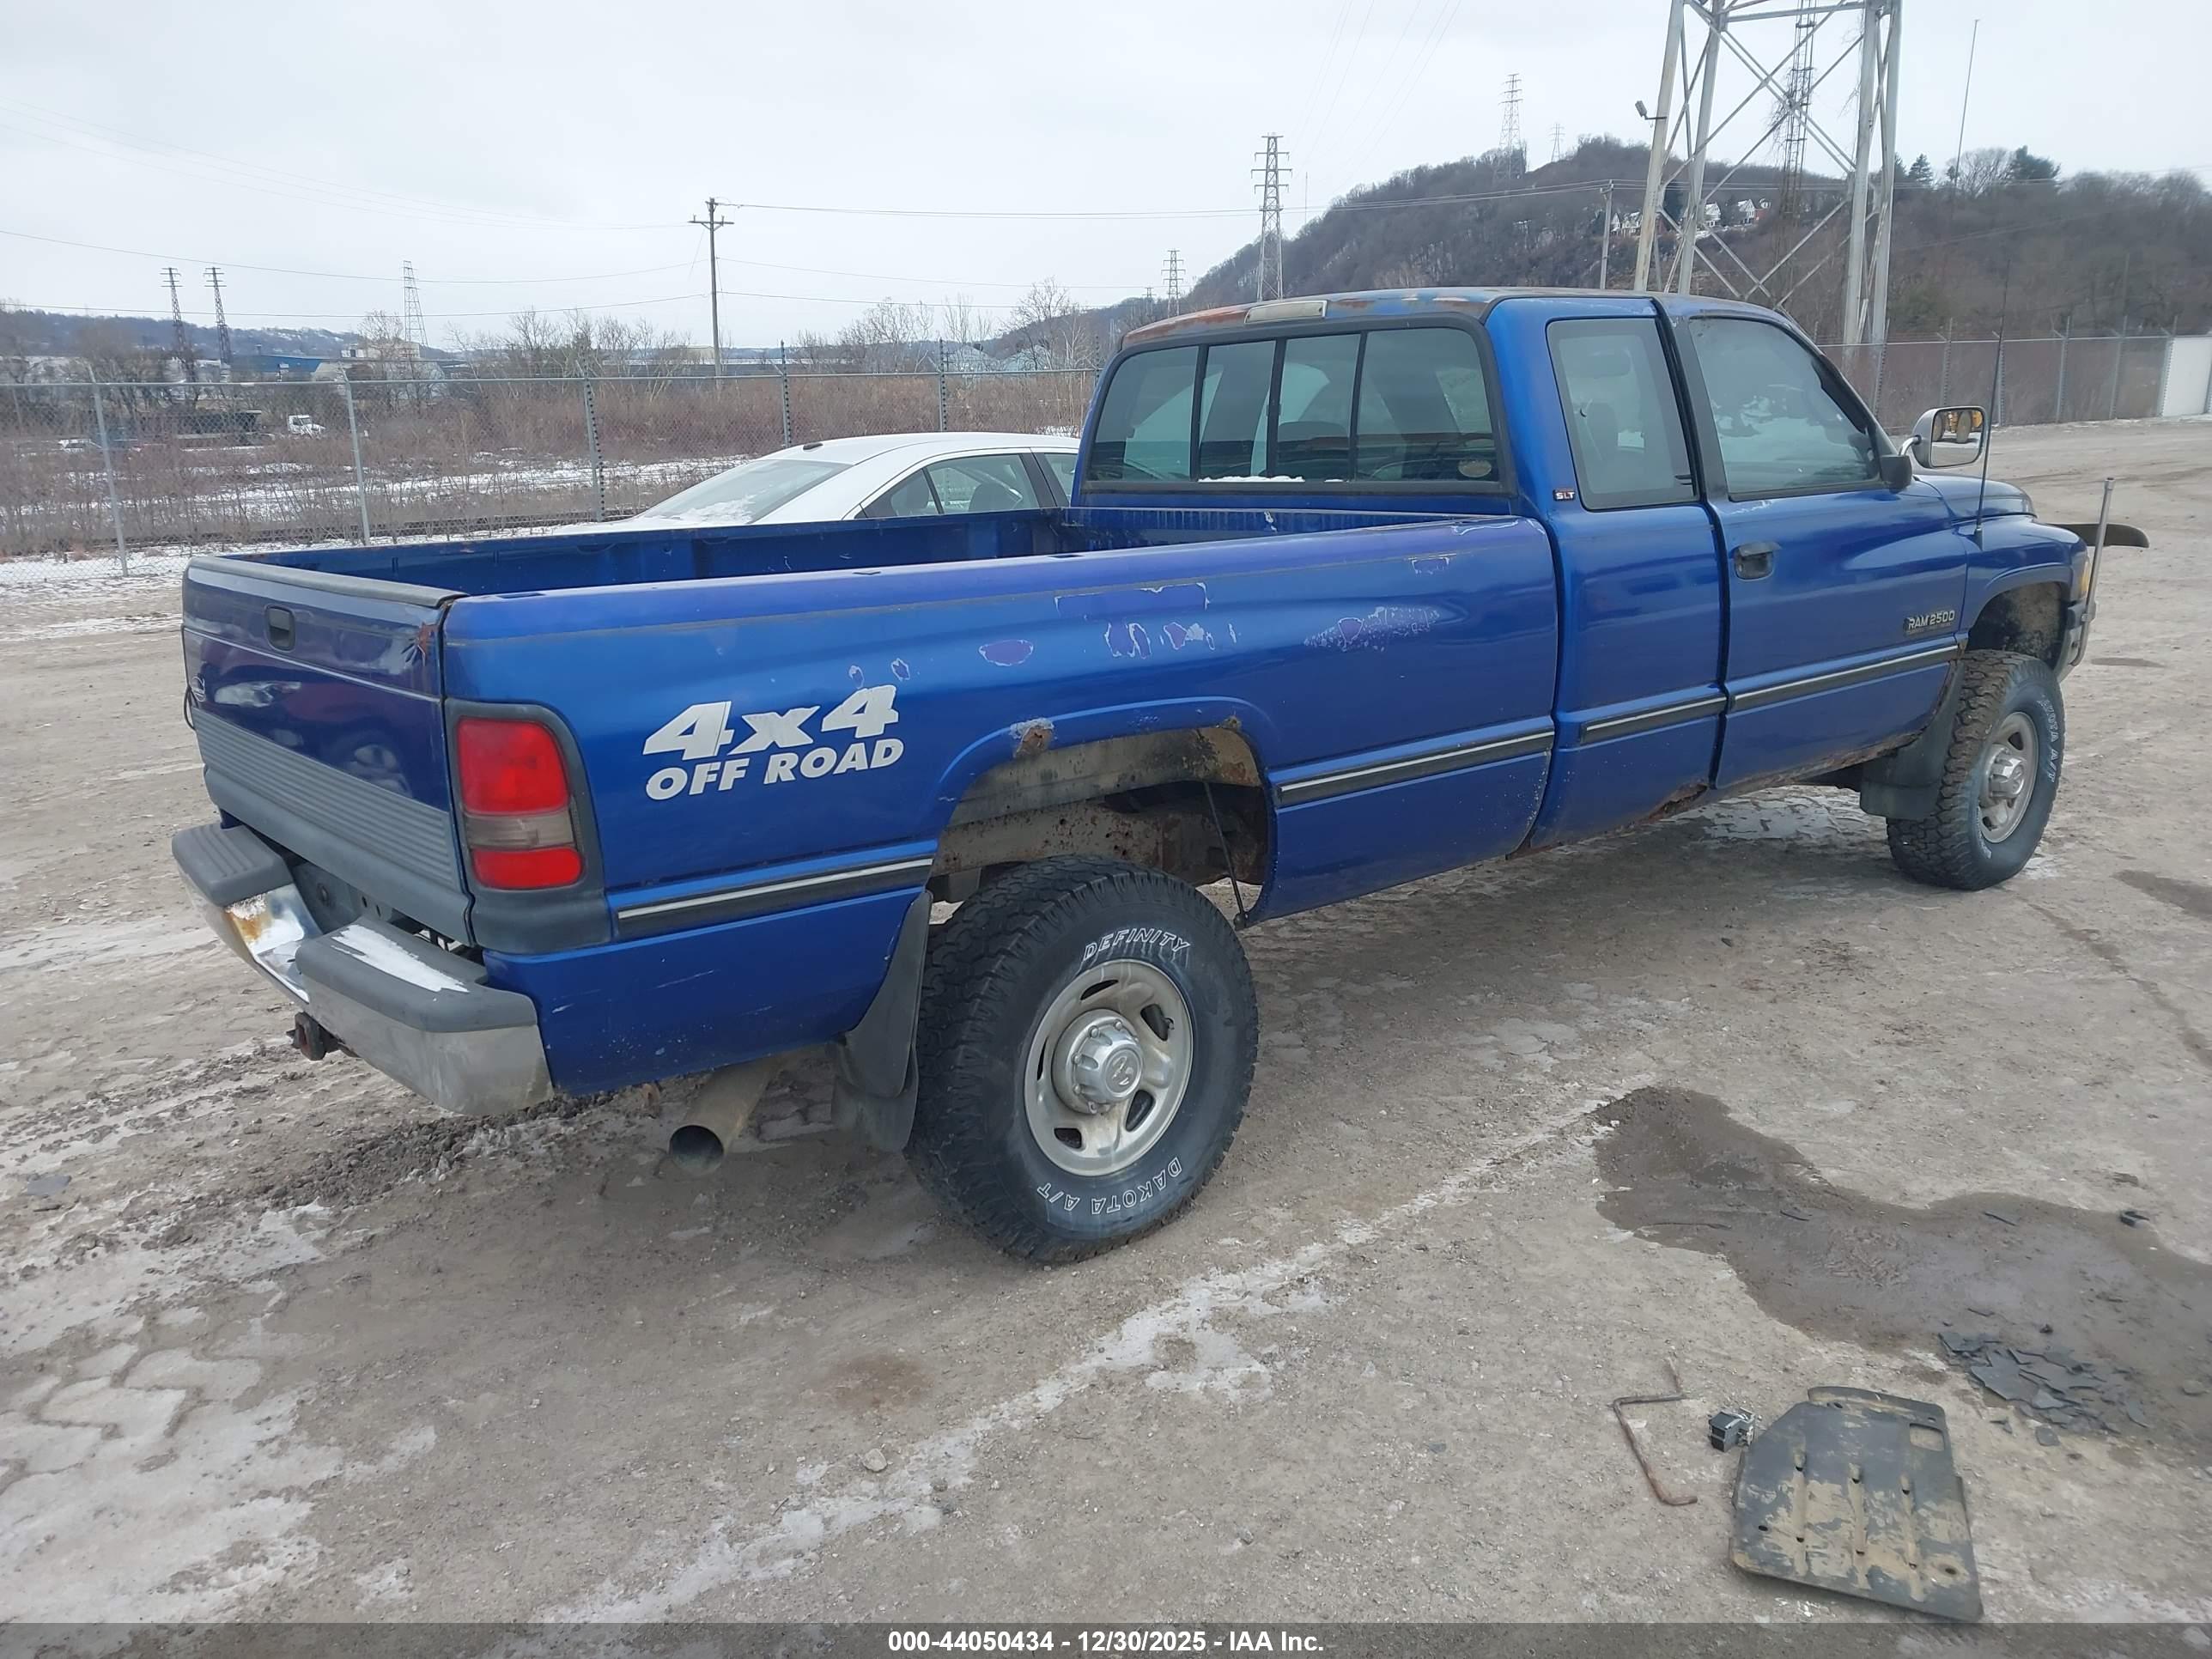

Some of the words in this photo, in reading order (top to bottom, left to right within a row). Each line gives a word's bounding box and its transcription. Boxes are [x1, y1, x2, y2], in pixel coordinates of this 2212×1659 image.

[1555, 491, 1575, 500] SLT
[1907, 615, 1929, 629] RAM
[1929, 610, 1955, 625] 2500
[642, 684, 900, 761] 4x4
[646, 757, 750, 800] OFF
[763, 738, 905, 785] ROAD
[1083, 927, 1192, 962] DEFINITY
[1036, 1182, 1080, 1212] A/T
[1091, 1156, 1182, 1215] DAKOTA
